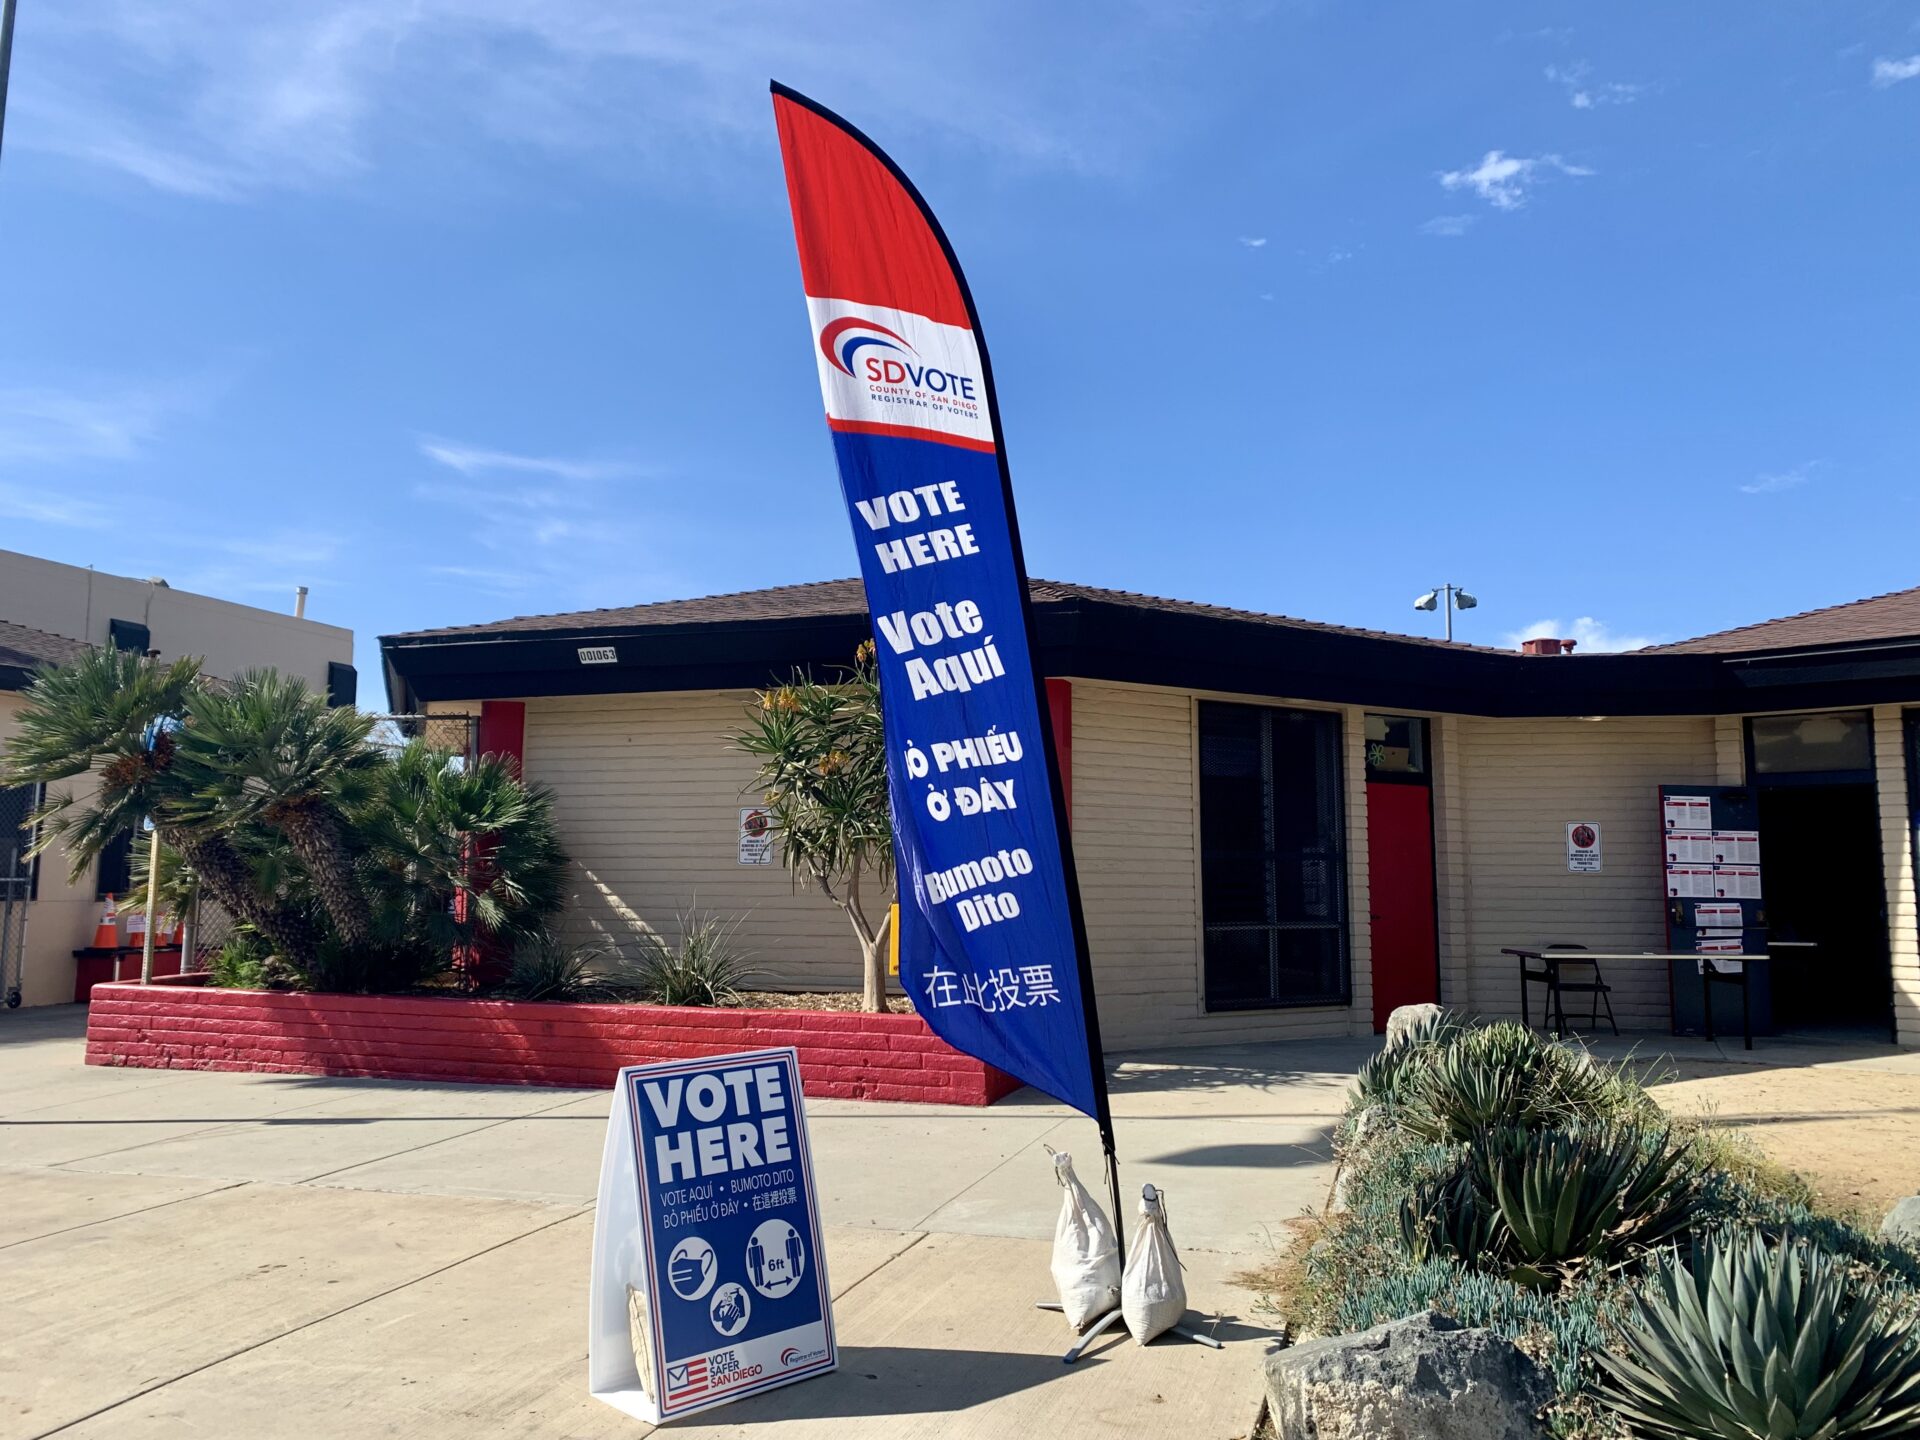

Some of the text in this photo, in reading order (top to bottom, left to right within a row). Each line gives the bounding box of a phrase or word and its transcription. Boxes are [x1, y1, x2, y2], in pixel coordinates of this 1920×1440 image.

[865, 357, 977, 401] SDVOTE
[869, 385, 979, 411] COUNTY OF SAN DIEGO
[871, 394, 928, 408] REGISTRAR
[947, 406, 979, 420] VOTERS
[855, 480, 966, 531] VOTE
[874, 523, 980, 575] HERE
[876, 600, 984, 655] Vote
[579, 649, 616, 661] 001063
[904, 634, 1006, 701] Aquí
[904, 724, 1023, 780] Ỏ PHIẾU
[953, 777, 1017, 816] ĐÂY
[924, 848, 1033, 905] Bumoto
[956, 891, 1021, 933] Dito
[923, 964, 1061, 1013] 在此投票
[643, 1065, 786, 1129] VOTE
[654, 1115, 793, 1184] HERE
[660, 1168, 795, 1207] VOTE AQUÍ BUMOTO DITO
[680, 1203, 709, 1226] PHIẾU
[721, 1198, 740, 1217] ĐÂY
[768, 1258, 785, 1272] 6ft
[708, 1350, 736, 1367] VOTE
[709, 1360, 740, 1378] SAFER
[711, 1364, 763, 1389] SAN DIEGO
